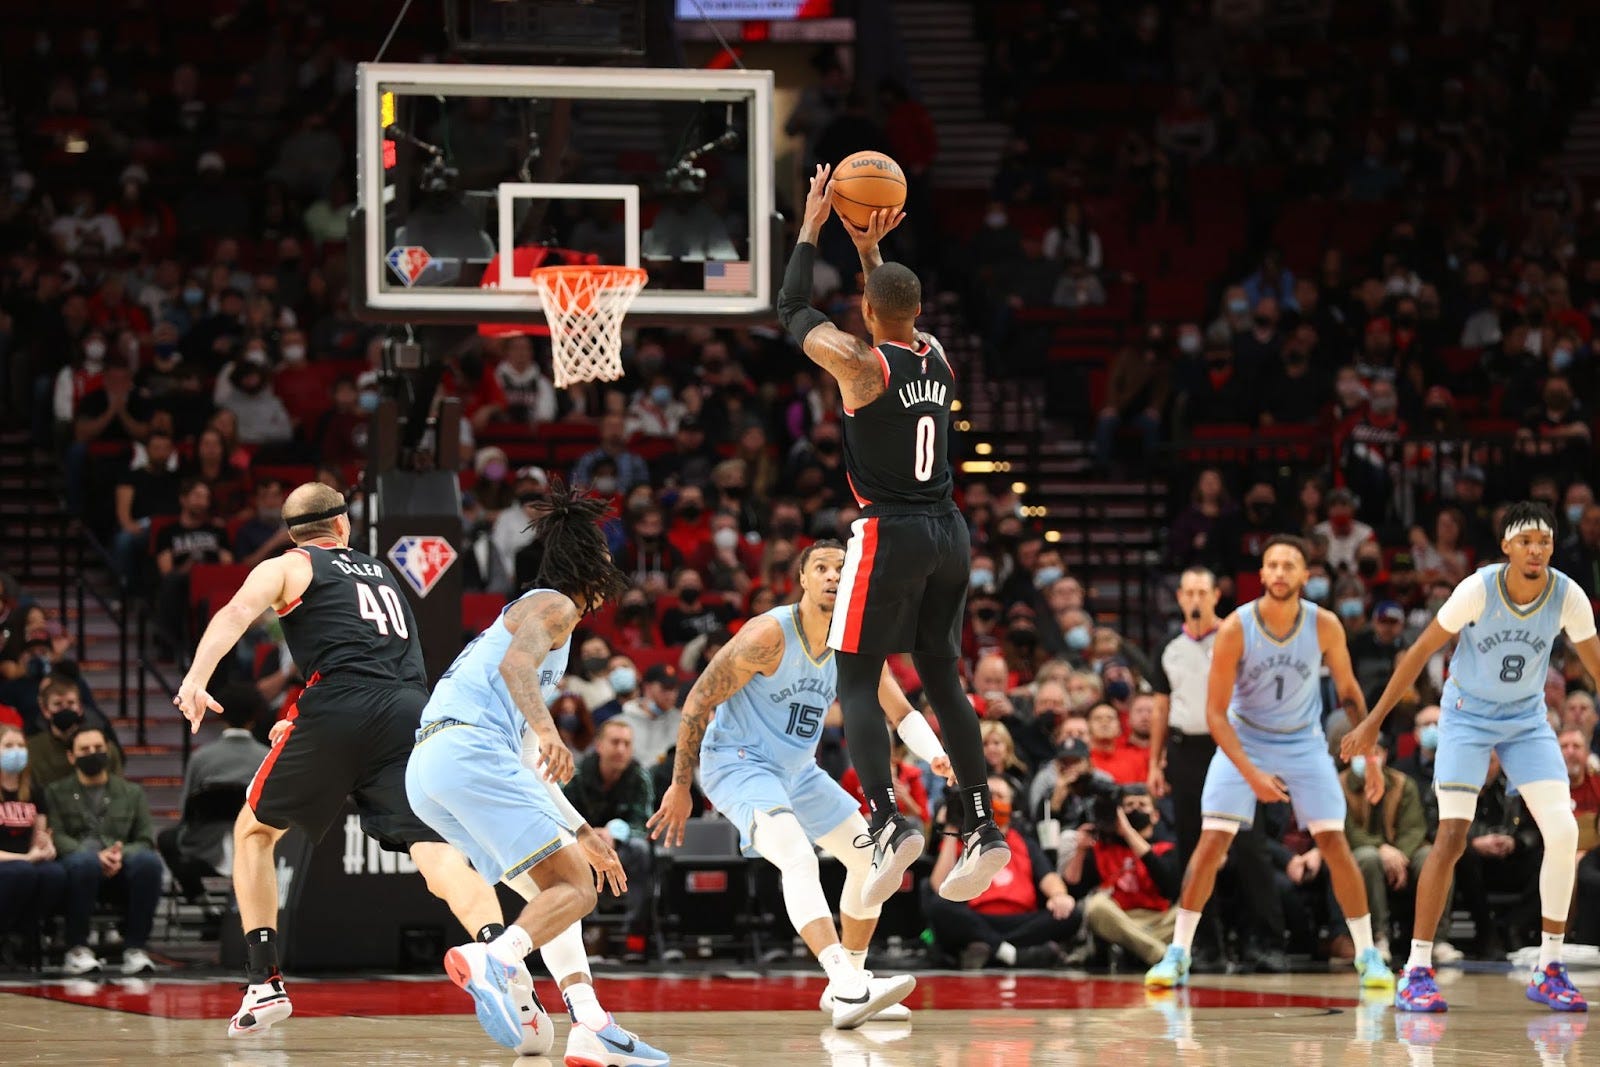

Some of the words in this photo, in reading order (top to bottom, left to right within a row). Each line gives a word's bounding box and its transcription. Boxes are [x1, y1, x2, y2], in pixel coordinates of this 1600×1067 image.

[898, 379, 947, 409] LILLARD
[914, 415, 935, 482] 0
[355, 582, 409, 640] 40
[1499, 654, 1526, 683] 8
[1274, 674, 1285, 701] 1
[784, 702, 824, 738] 15
